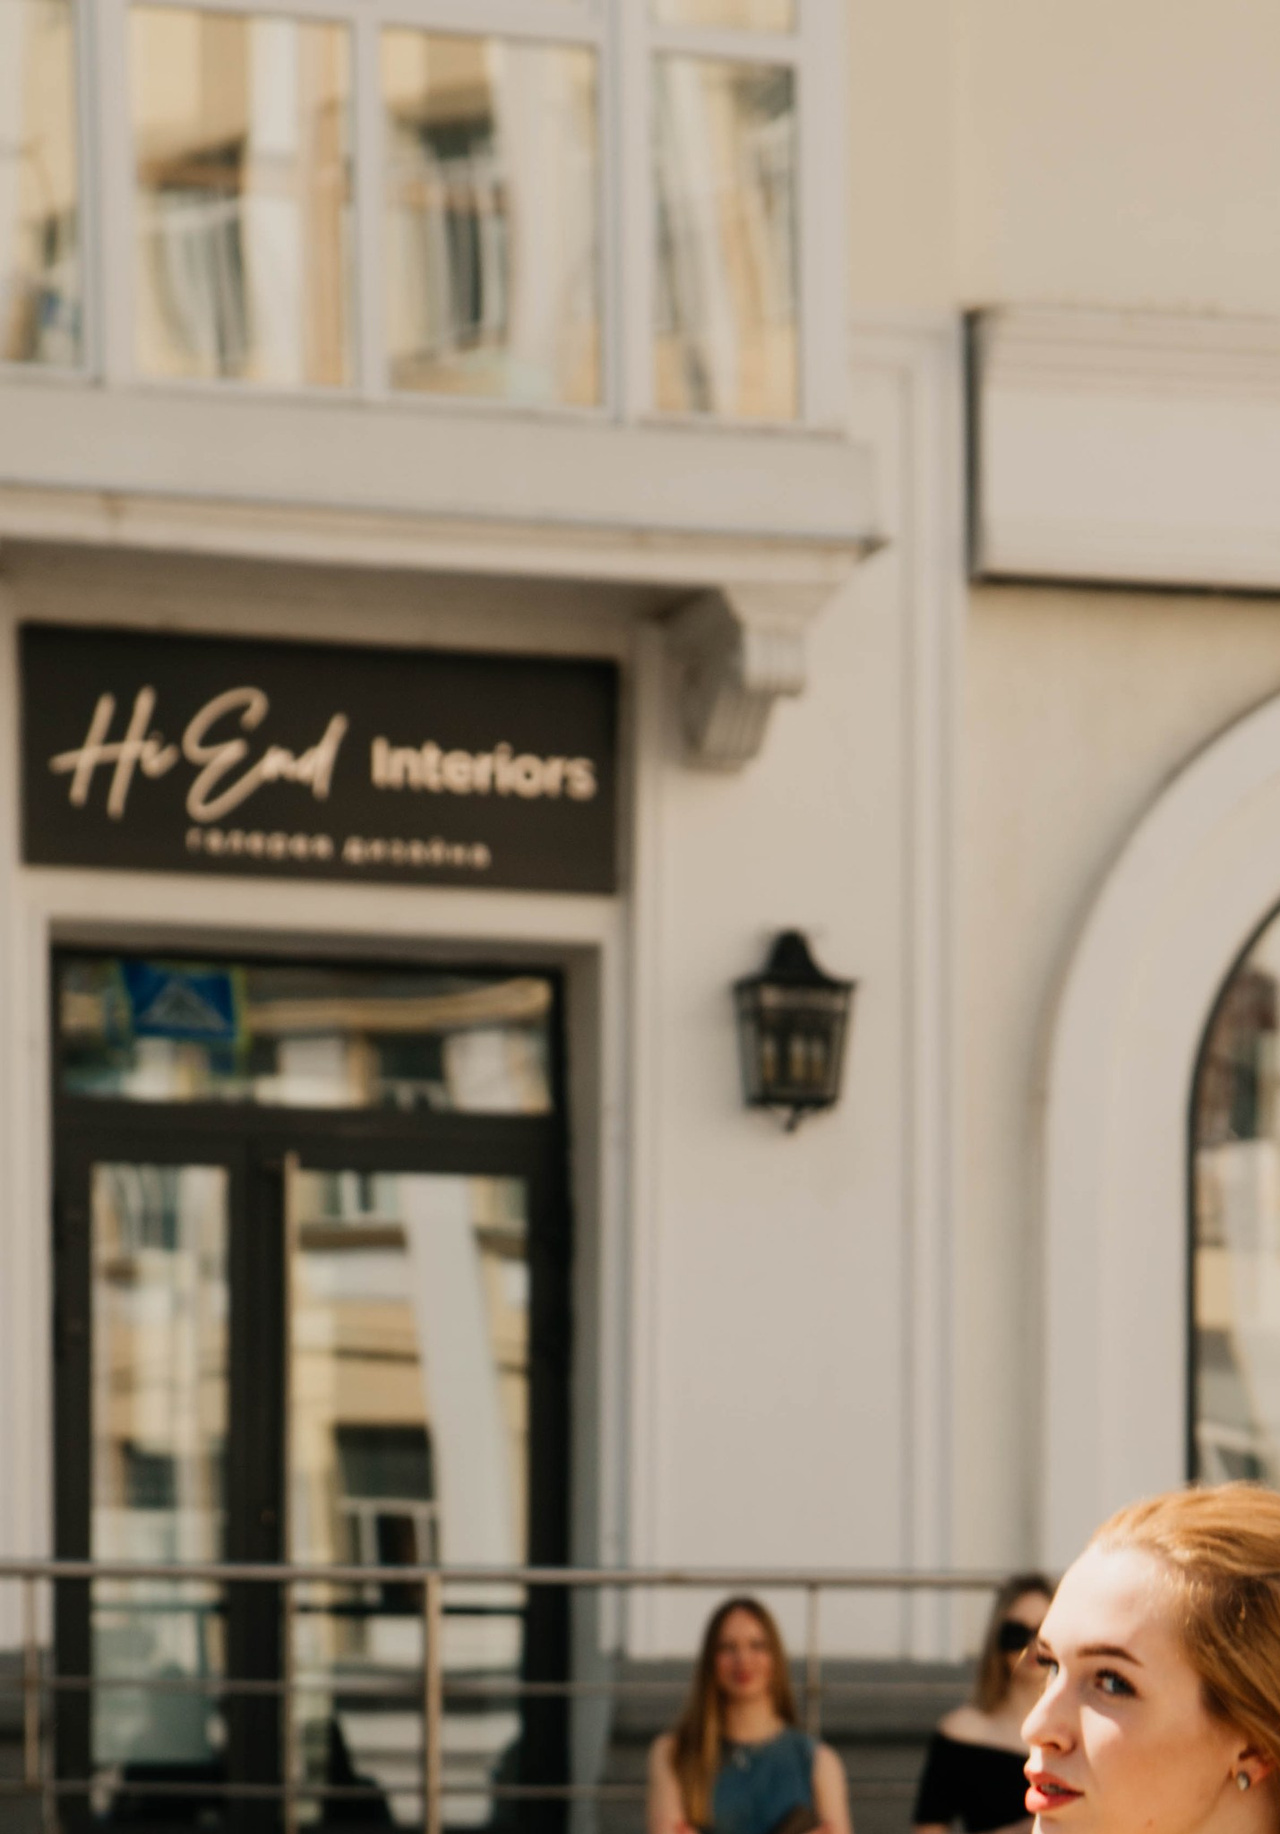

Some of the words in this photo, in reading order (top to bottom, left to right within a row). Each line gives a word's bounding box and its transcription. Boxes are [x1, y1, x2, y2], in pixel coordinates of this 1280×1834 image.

[49, 685, 180, 820] Hi
[181, 686, 349, 823] End
[370, 735, 598, 801] Interiors
